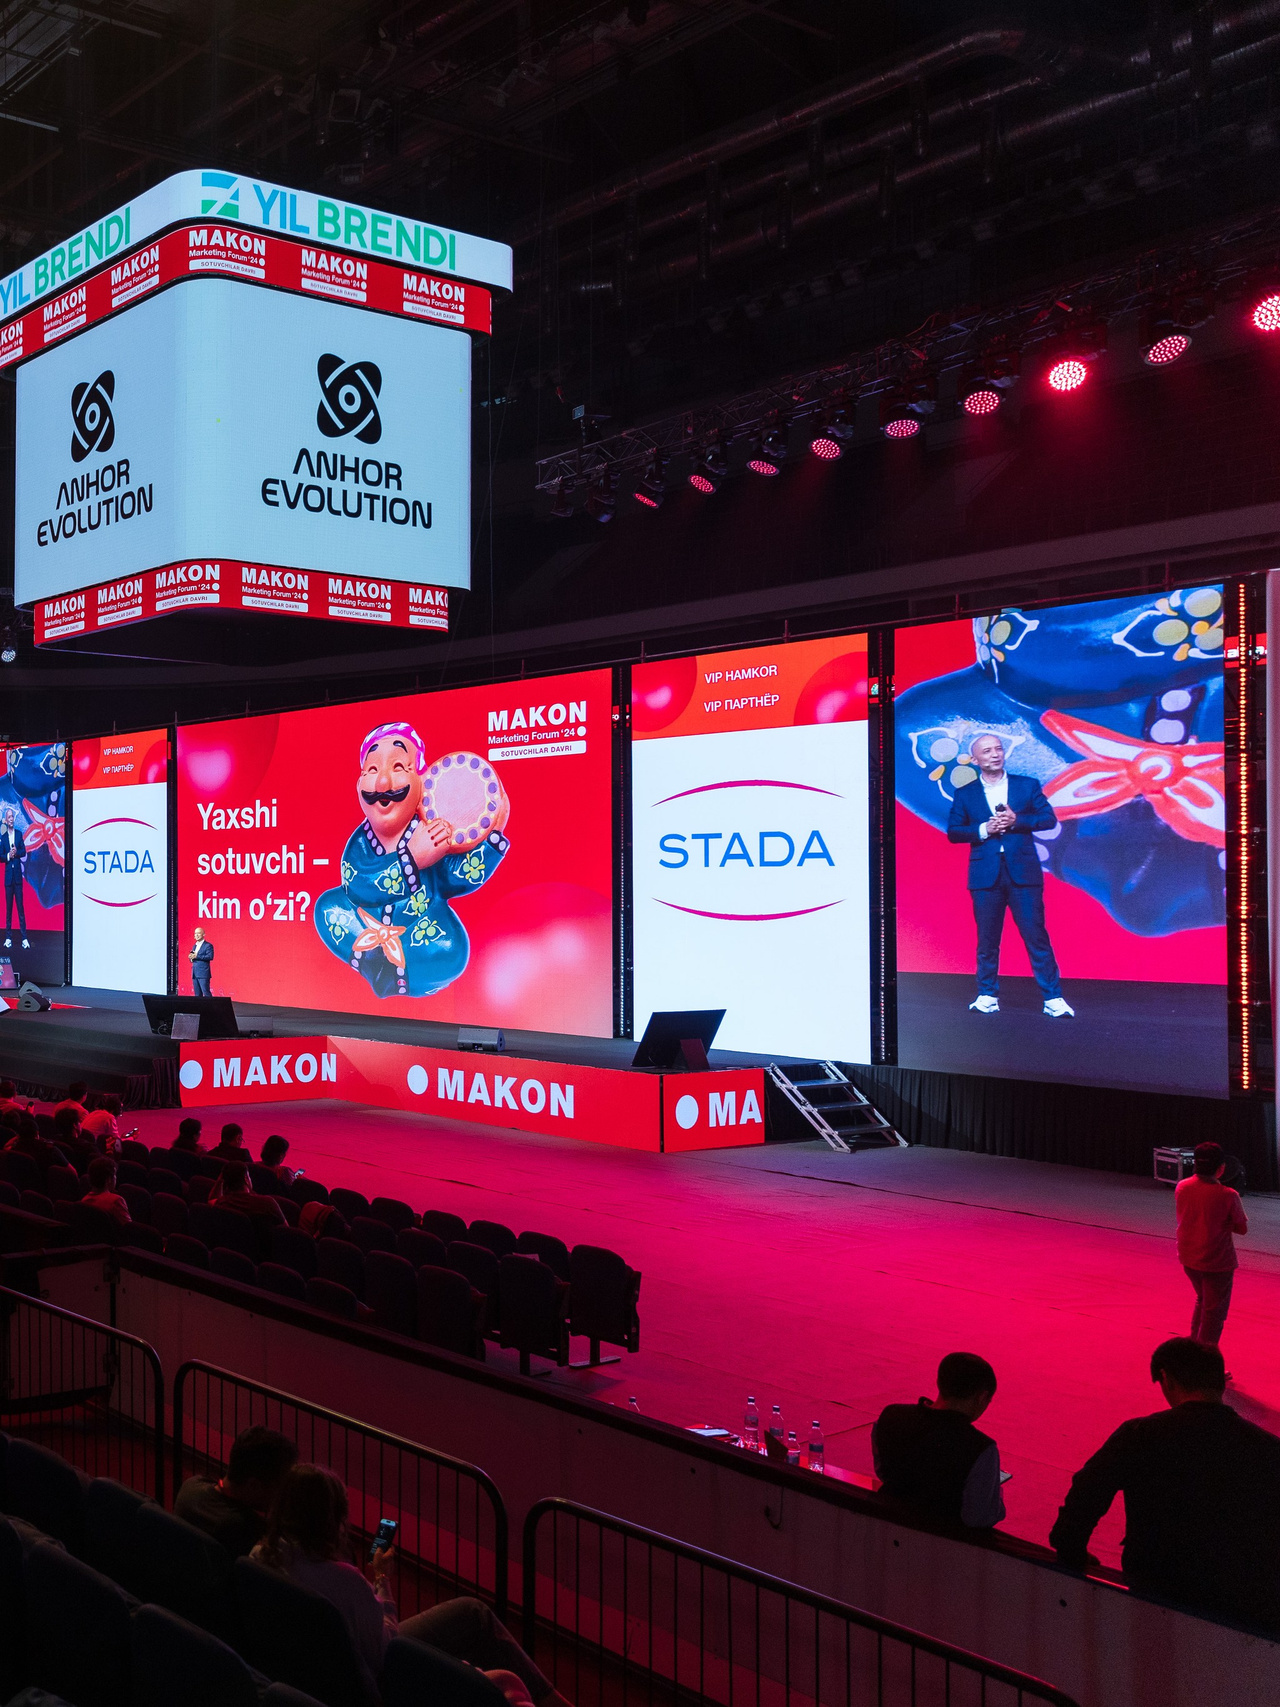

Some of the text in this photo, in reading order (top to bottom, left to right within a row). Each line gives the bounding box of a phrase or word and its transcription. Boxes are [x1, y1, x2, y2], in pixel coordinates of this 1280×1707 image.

[253, 184, 456, 271] YIL BRENDI
[189, 229, 266, 256] MAKON
[0, 206, 131, 314] YIL BRENDI
[111, 245, 159, 286] MAKON
[189, 249, 226, 258] Marketing
[228, 250, 248, 262] Forum
[201, 261, 240, 272] SOTUVCHILAR
[301, 249, 367, 280] MAKON
[111, 280, 132, 296] Marketing
[133, 272, 147, 284] Forum
[301, 268, 330, 283] Marketing
[331, 274, 350, 286] Forum
[403, 273, 465, 303] MAKON
[43, 286, 86, 323] MAKON
[403, 292, 430, 306] Marketing
[431, 298, 449, 309] Forum
[293, 447, 402, 491] ANHOR
[56, 459, 130, 510] ANHOR
[37, 484, 153, 547] EVOLUTION
[261, 478, 432, 530] EVOLUTION
[156, 564, 220, 589] MAKON
[241, 566, 309, 591] MAKON
[328, 577, 392, 600] MAKON
[97, 578, 142, 605] MAKON
[156, 588, 177, 599] Marketing
[177, 585, 197, 594] Forum
[241, 585, 271, 597] Marketing
[272, 589, 291, 598] Forum
[328, 596, 356, 608] Marketing
[357, 599, 375, 609] Forum
[44, 594, 85, 619] MAKON
[97, 603, 117, 614] Marketing
[117, 600, 130, 609] Forum
[409, 605, 436, 616] Marketing
[44, 618, 62, 628] Marketing
[62, 614, 74, 624] Forum
[705, 665, 778, 684] VIP HAMKOR
[704, 693, 780, 713] VIP ПАРТНЁР
[488, 700, 587, 732] MAKON
[488, 732, 529, 746] Marketing
[531, 729, 560, 741] Forum
[103, 746, 134, 756] VIP HAMKOR
[500, 745, 572, 758] SOTUVCHILAR DAVRI
[102, 766, 111, 774] VIP
[197, 799, 277, 831] Yaxshi
[84, 850, 155, 874] STADA
[197, 844, 305, 875] sotuvchi
[658, 830, 835, 869] STADA
[198, 891, 241, 920] kim
[213, 1053, 337, 1088] MAKON
[437, 1068, 575, 1118] MAKON
[708, 1089, 763, 1128] MA
